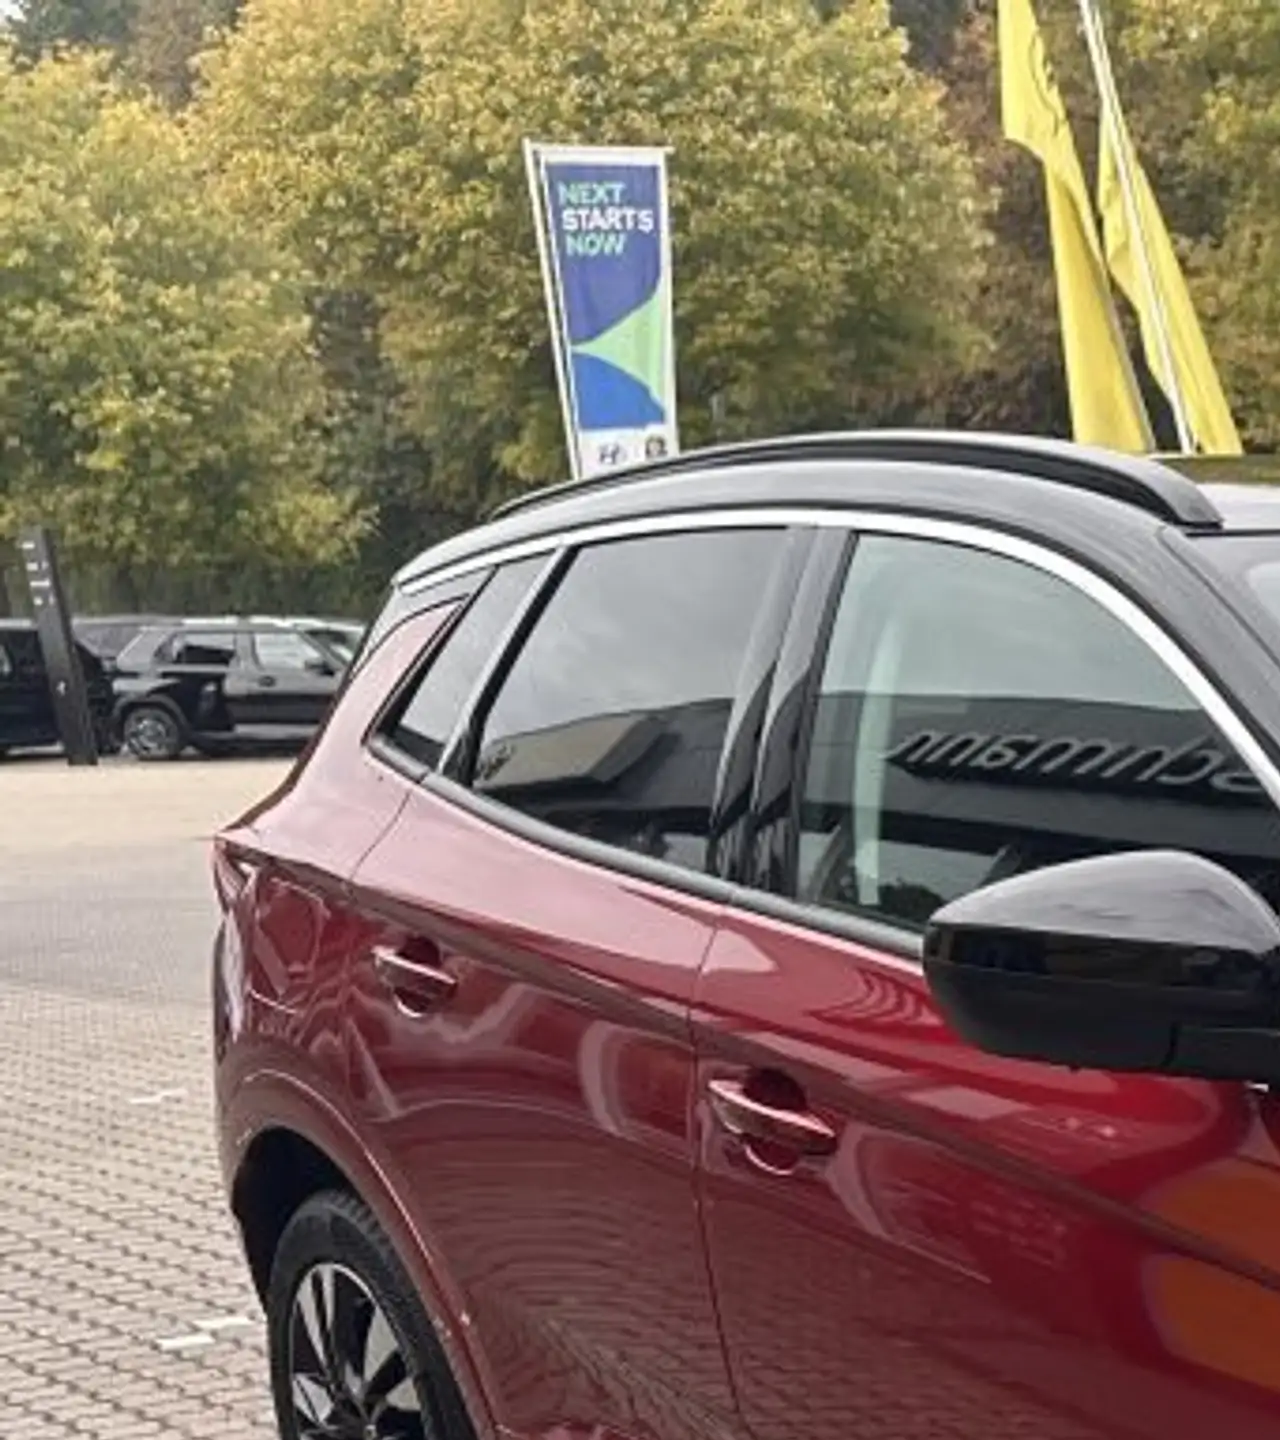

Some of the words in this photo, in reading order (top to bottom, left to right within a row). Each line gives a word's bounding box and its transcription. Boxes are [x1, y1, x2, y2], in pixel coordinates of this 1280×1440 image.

[558, 182, 625, 205] NEXT
[562, 207, 654, 233] STARTS
[566, 232, 626, 256] NOW
